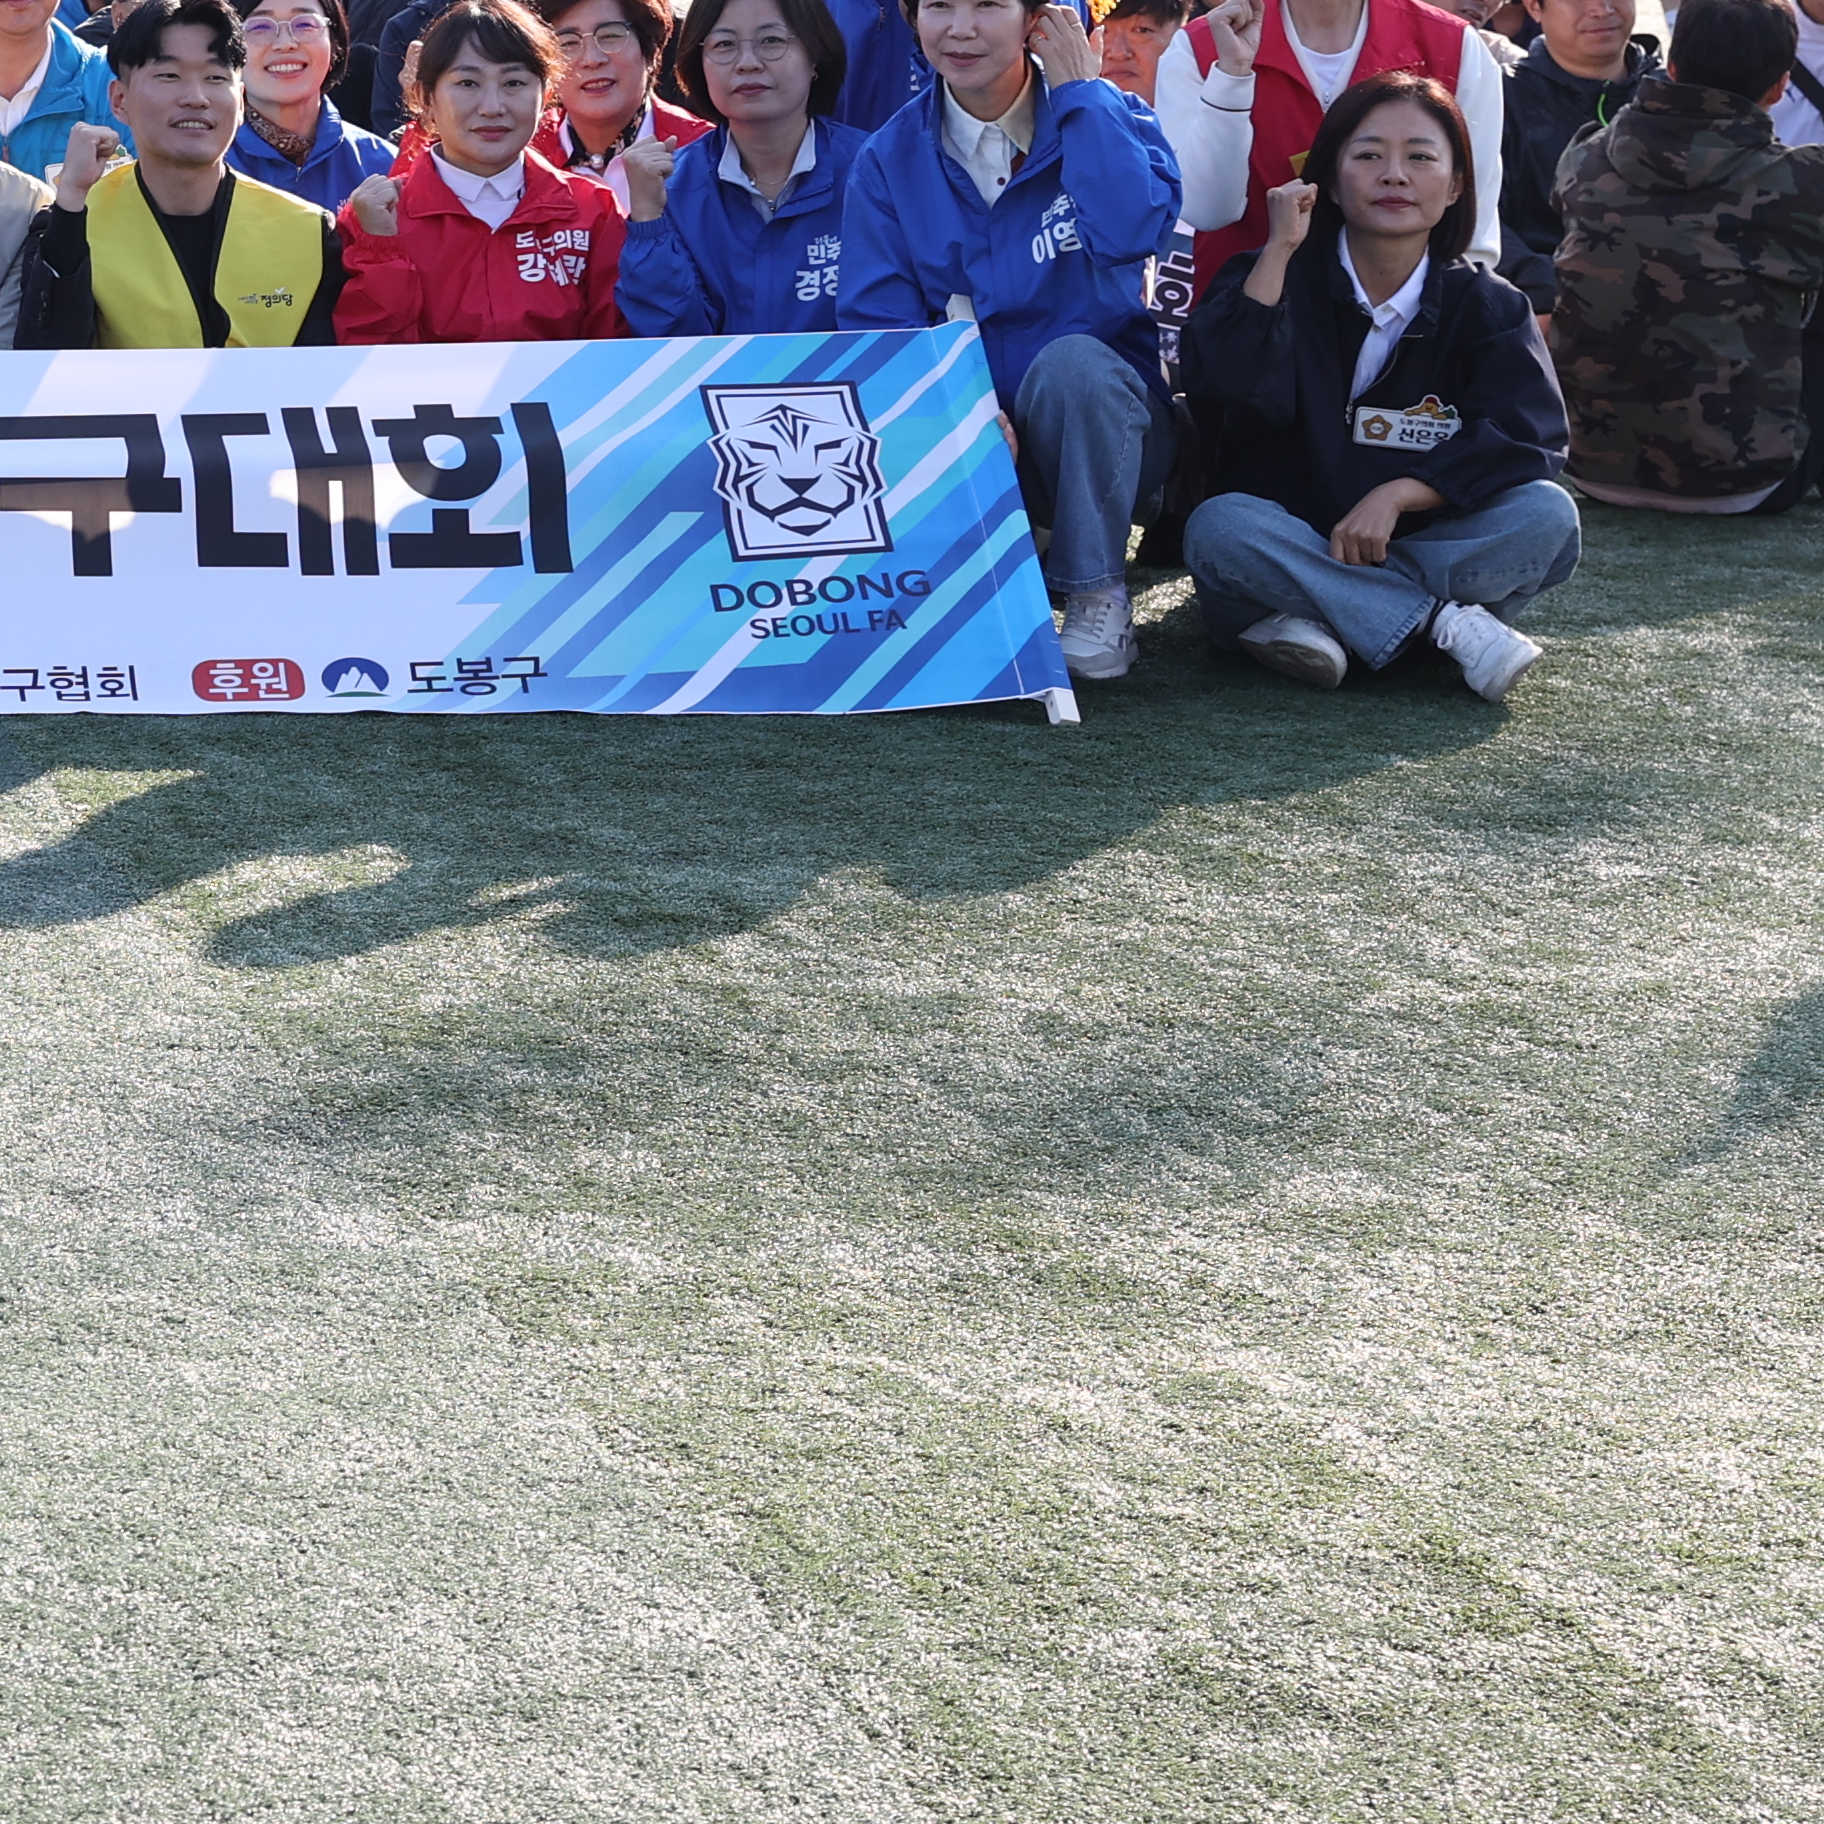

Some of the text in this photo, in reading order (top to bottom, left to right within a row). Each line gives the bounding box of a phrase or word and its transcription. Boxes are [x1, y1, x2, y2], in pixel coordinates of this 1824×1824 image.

[515, 229, 590, 257] 도구의원
[260, 293, 294, 308] 정의당
[708, 568, 933, 614] DOBONG
[749, 609, 908, 641] SEOUL FA
[206, 659, 294, 701] 후원
[405, 654, 549, 698] 도봉구
